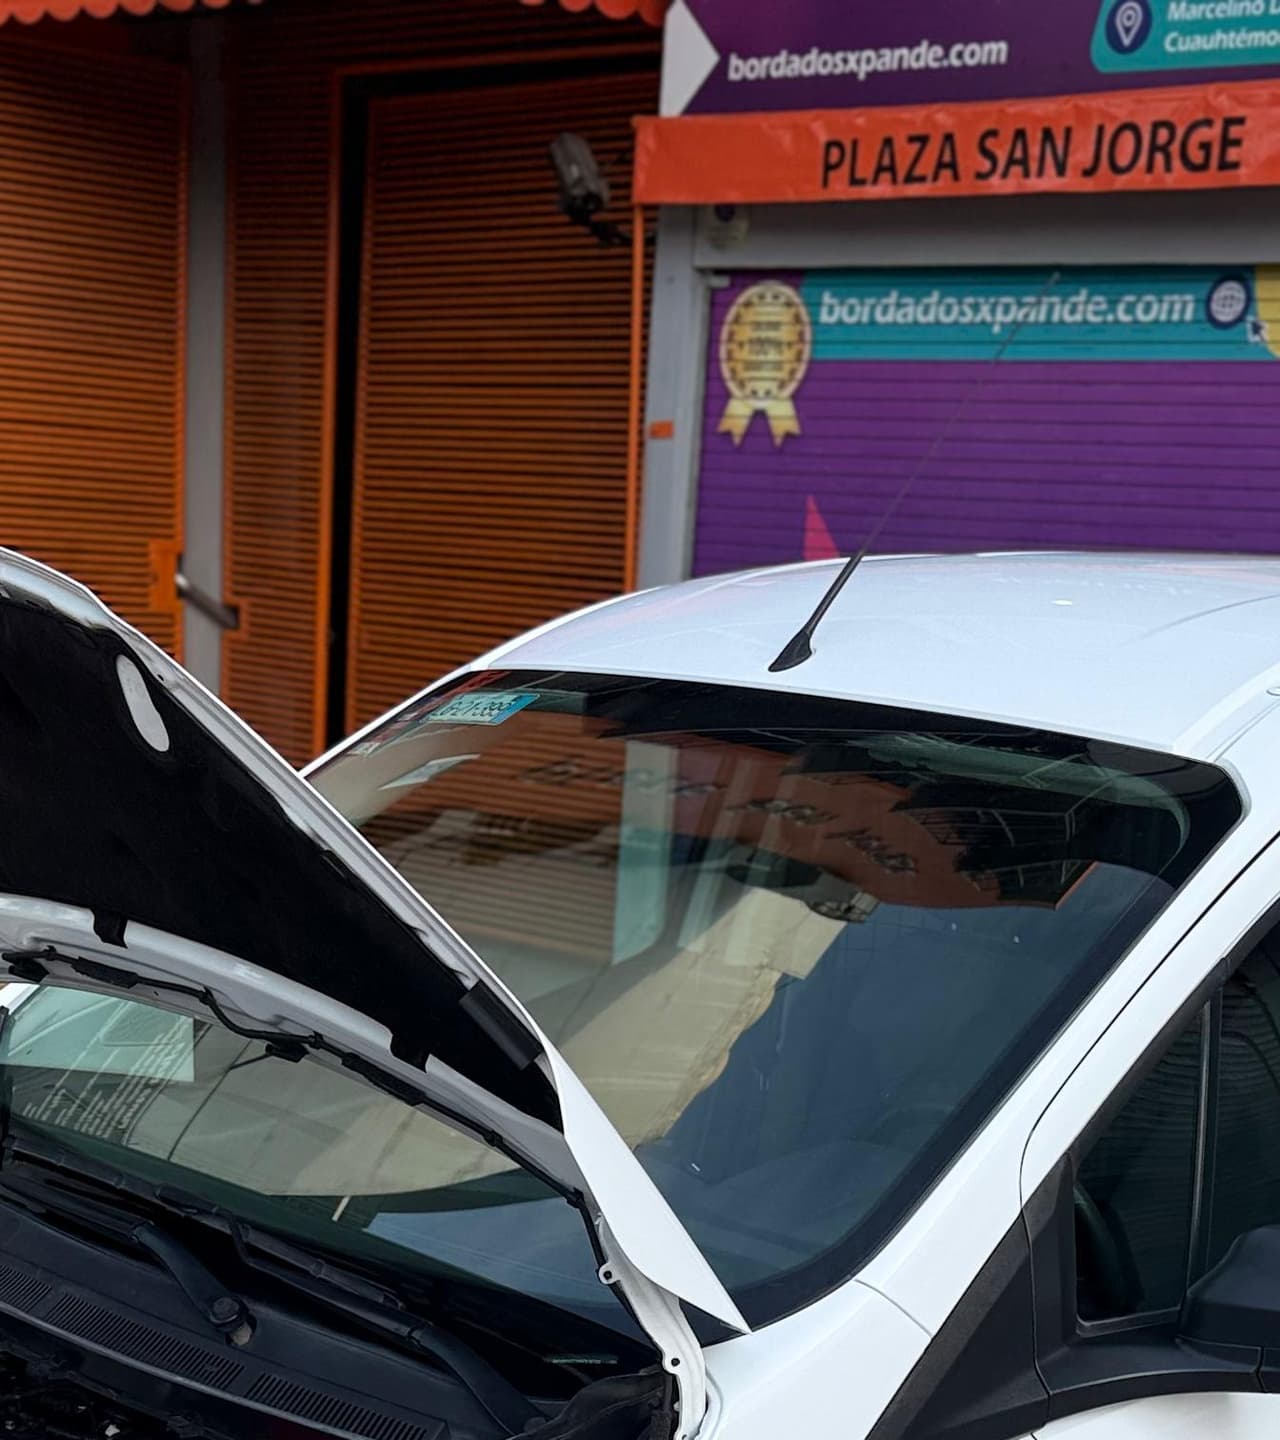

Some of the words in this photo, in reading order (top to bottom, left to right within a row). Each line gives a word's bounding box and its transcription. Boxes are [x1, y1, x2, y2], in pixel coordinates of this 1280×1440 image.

[1167, 0, 1265, 21] Marcelino
[728, 39, 1008, 81] bordadosxpande.com
[822, 132, 961, 188] PLAZA
[974, 126, 1072, 181] SAN
[1082, 116, 1246, 178] JORGE
[819, 287, 1195, 332] bordadosxpande.com
